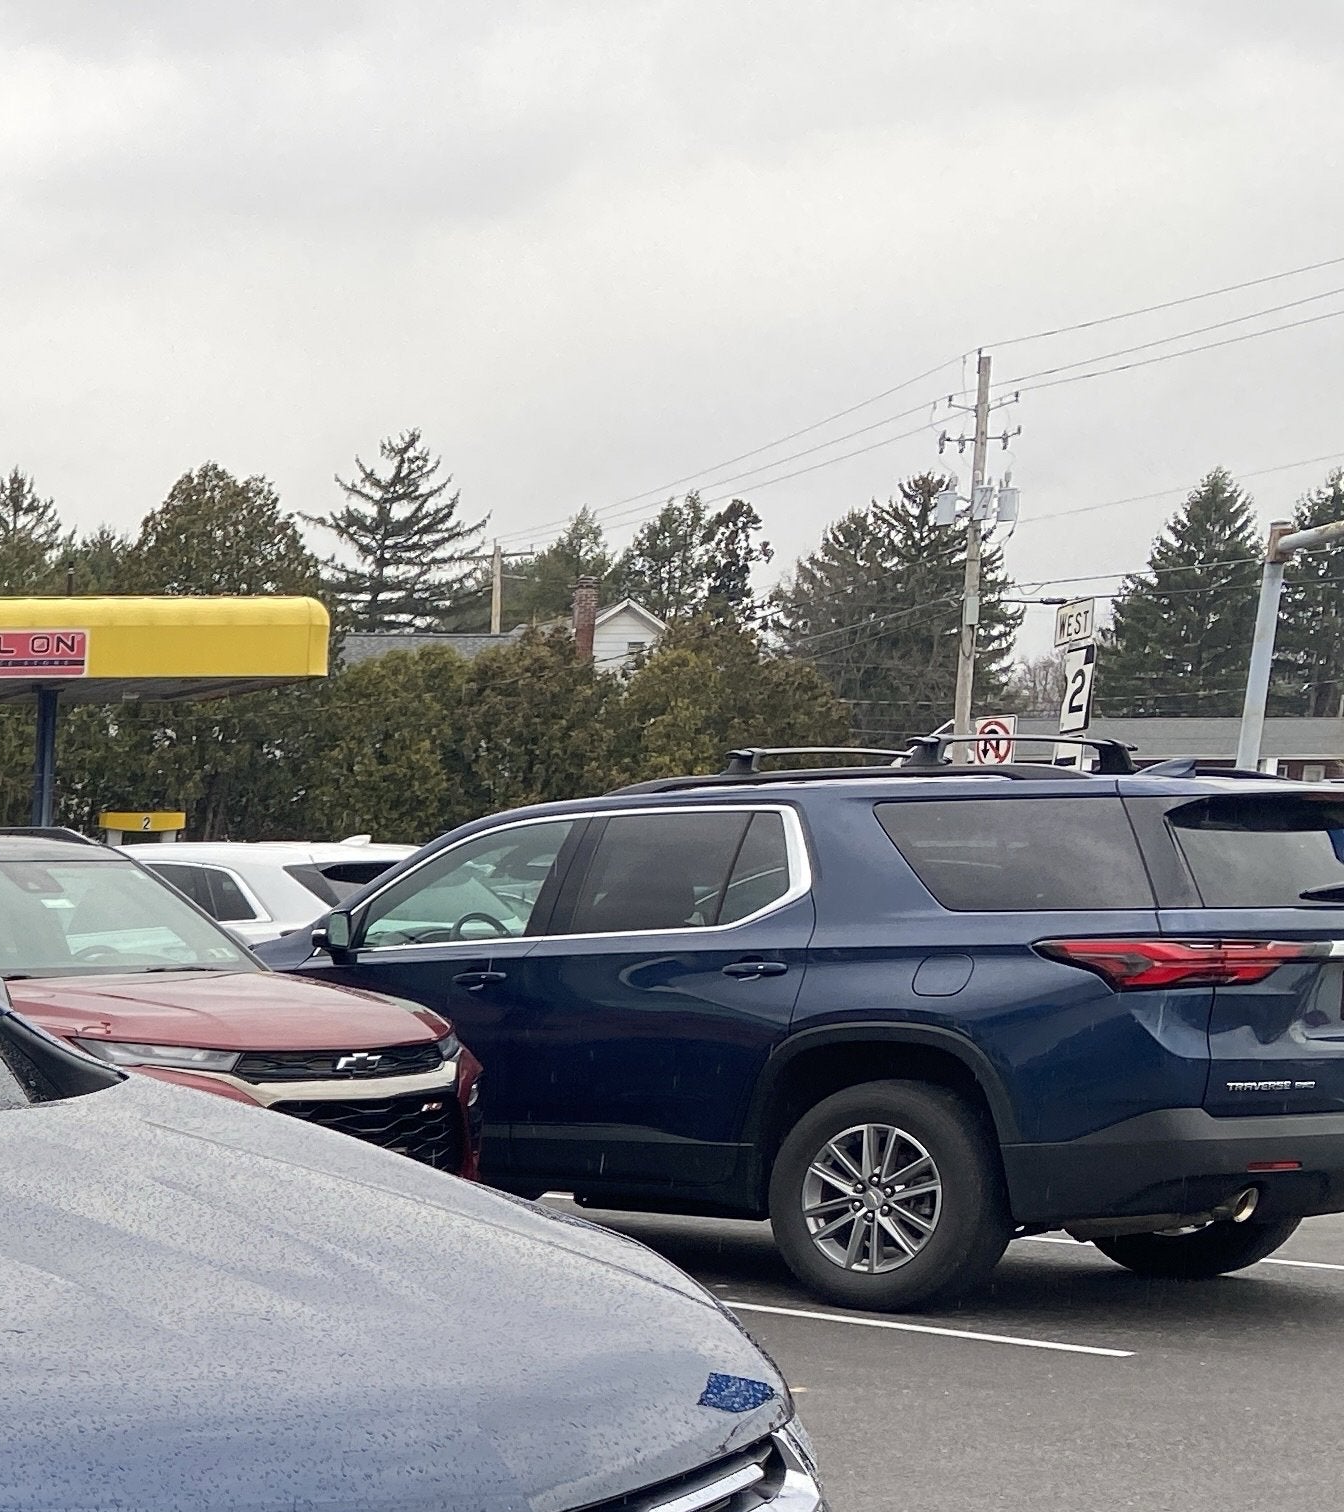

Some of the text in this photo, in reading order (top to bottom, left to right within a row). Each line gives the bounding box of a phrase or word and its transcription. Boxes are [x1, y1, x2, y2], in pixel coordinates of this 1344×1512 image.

[1059, 609, 1090, 639] WEST
[31, 634, 76, 654] ON
[1067, 668, 1086, 714] 2
[142, 816, 151, 830] 2
[1226, 1080, 1292, 1091] TRAVERSE
